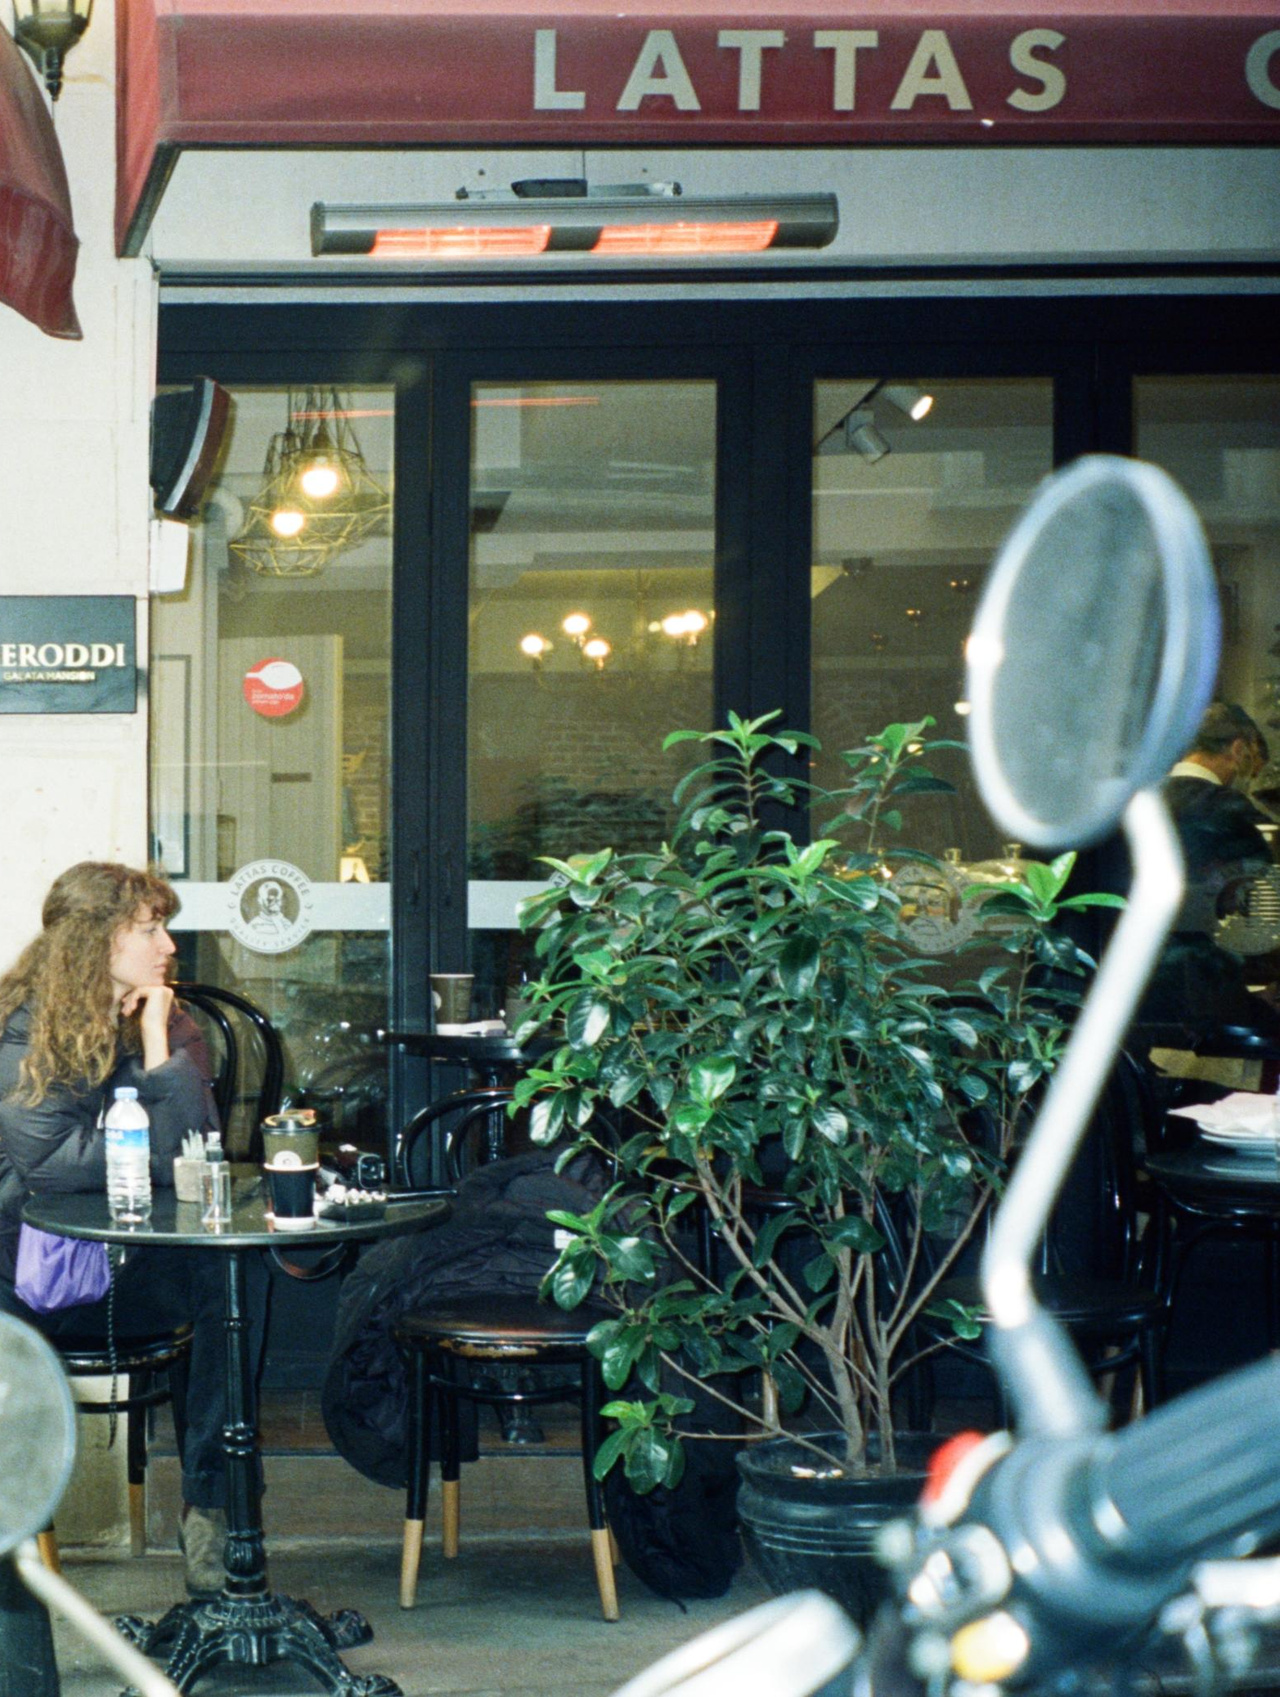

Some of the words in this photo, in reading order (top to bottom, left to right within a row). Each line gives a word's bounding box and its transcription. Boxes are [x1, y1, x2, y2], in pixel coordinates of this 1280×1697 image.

[533, 28, 1067, 112] LATTAS
[230, 865, 267, 896] LATTAS
[272, 865, 311, 896] COFFEE
